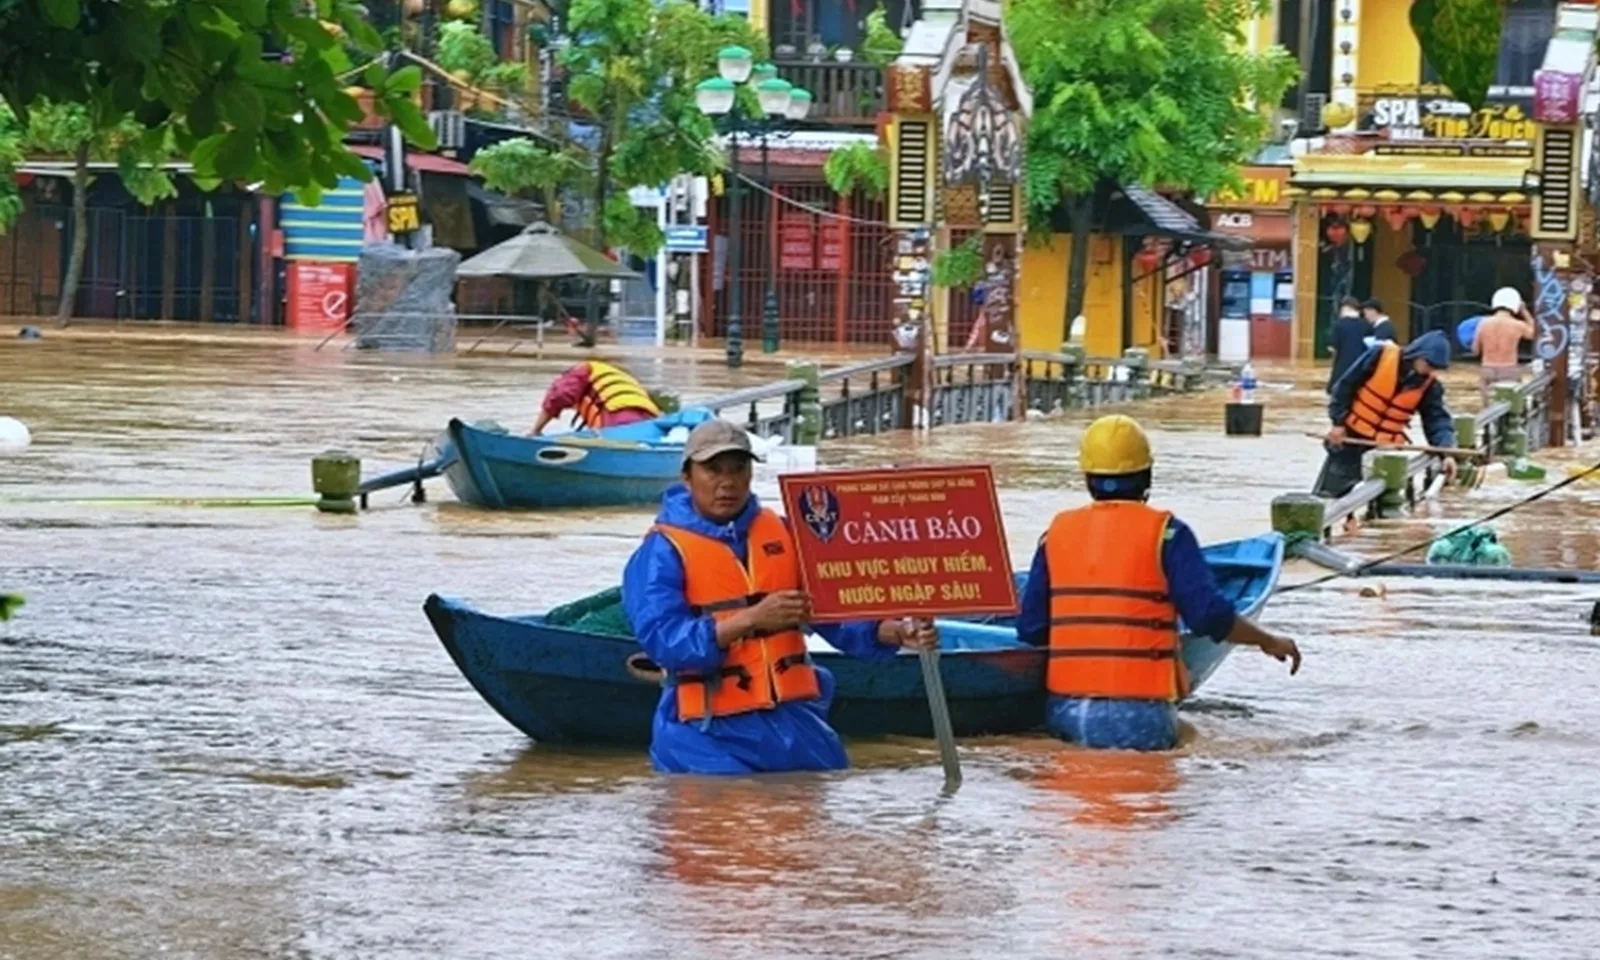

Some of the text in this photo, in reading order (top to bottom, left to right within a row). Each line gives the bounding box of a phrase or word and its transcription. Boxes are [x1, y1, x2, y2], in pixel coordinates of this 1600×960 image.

[1374, 98, 1420, 126] SPA
[389, 205, 419, 231] SPA
[1216, 212, 1252, 228] ACB
[843, 510, 982, 544] CẢNH BÁO
[816, 560, 852, 579] KHU
[855, 557, 890, 580] VỰC
[893, 556, 939, 575] NGUY
[838, 580, 982, 605] NƯỚC NGẬP SÂU!
